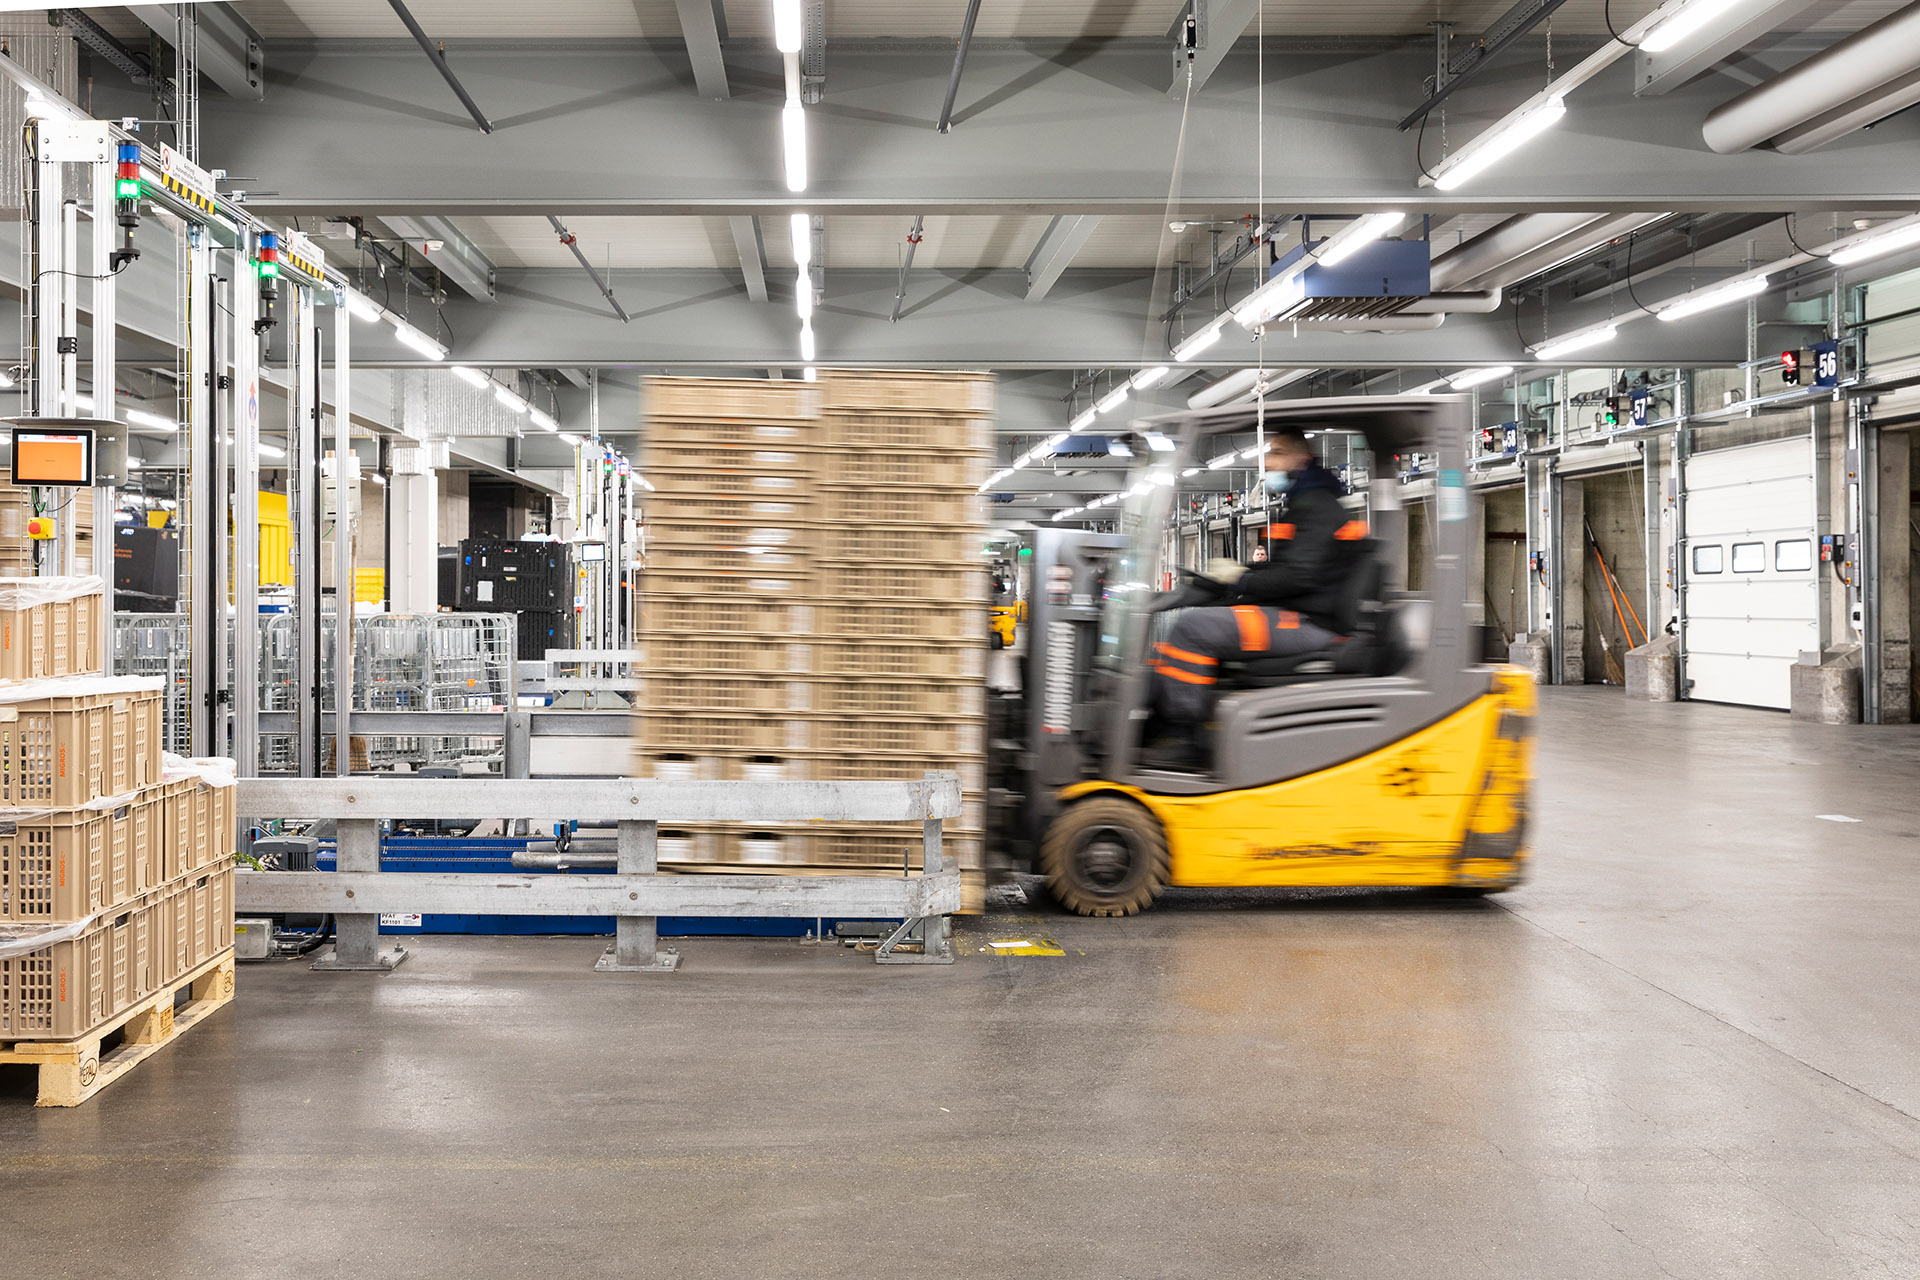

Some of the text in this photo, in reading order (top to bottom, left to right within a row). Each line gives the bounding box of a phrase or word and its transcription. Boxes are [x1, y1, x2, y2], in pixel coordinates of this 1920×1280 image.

[1819, 351, 1836, 378] 56
[1634, 398, 1646, 420] 57
[1507, 429, 1516, 448] 58
